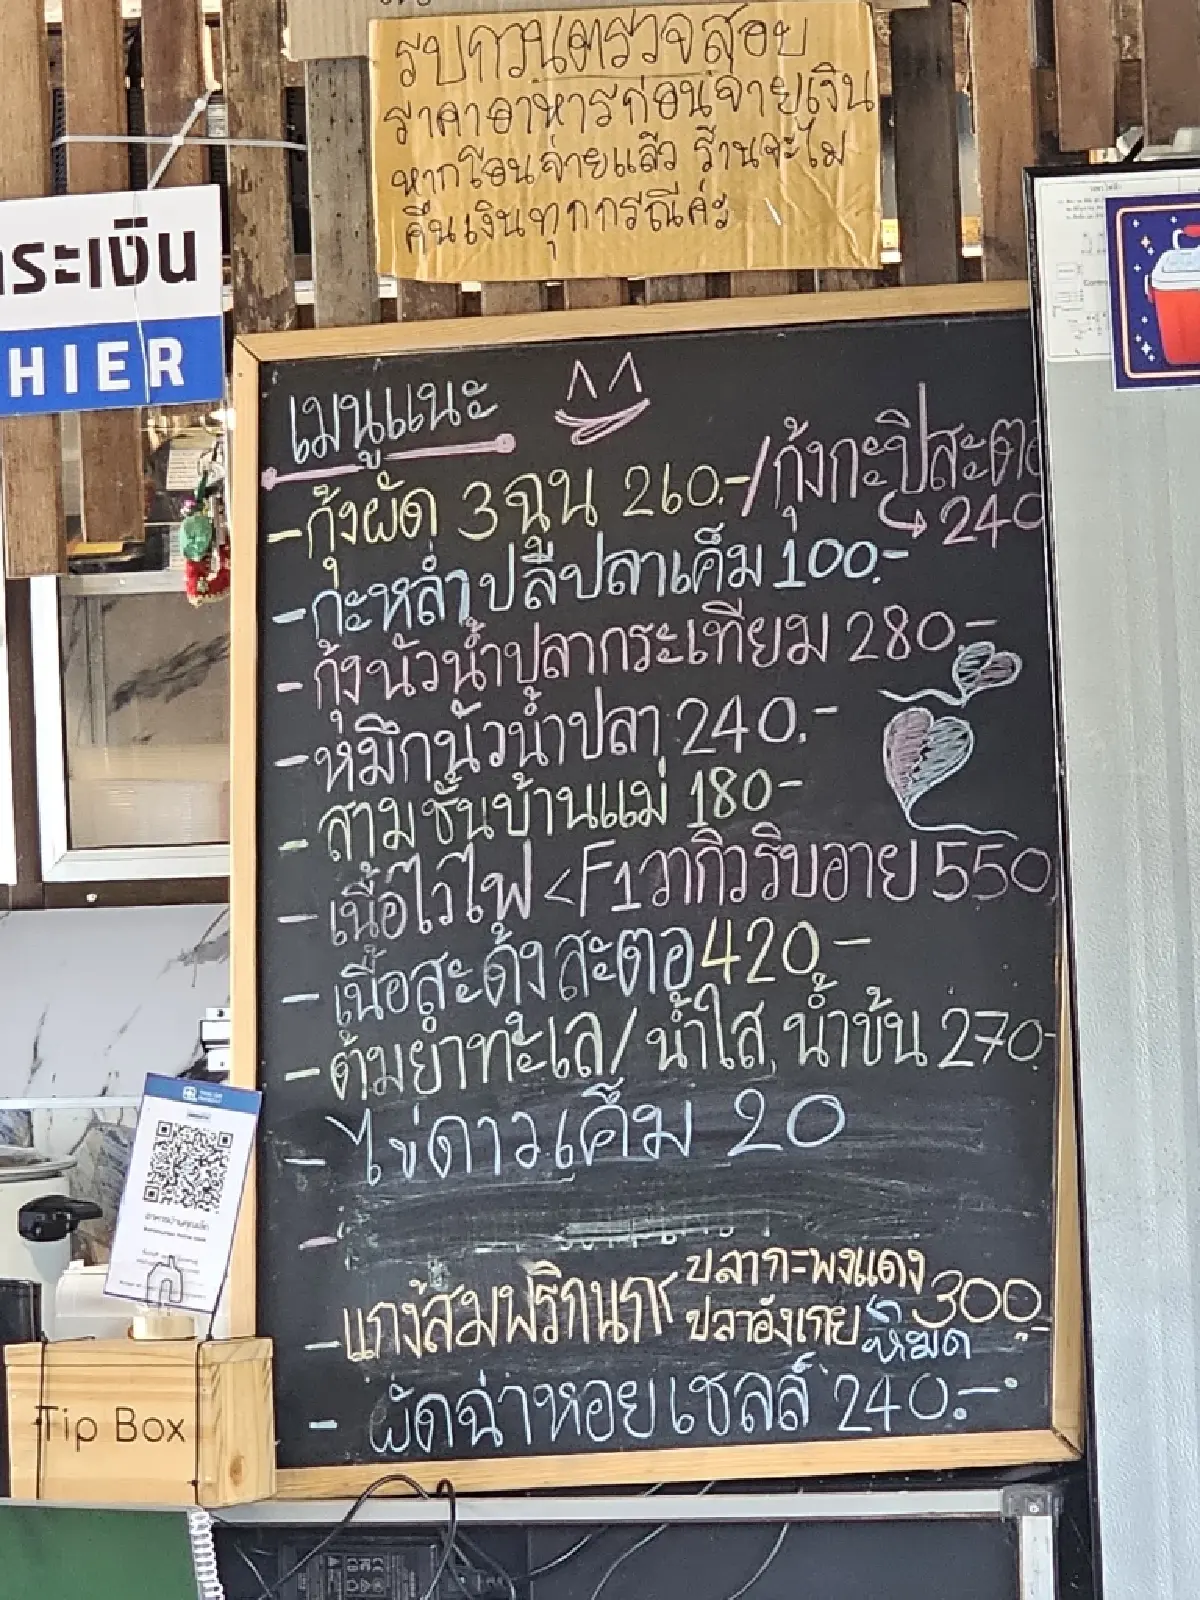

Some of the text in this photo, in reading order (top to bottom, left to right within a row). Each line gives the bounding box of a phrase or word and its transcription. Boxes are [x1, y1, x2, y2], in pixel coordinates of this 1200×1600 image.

[396, 3, 807, 87] รบกวนตรวจสอบ
[0, 216, 197, 295] ระเงิน
[9, 336, 185, 398] HIER
[291, 380, 499, 469] เมนูแนะ
[728, 1088, 846, 1157] 20
[34, 1405, 186, 1453] Tip Box
